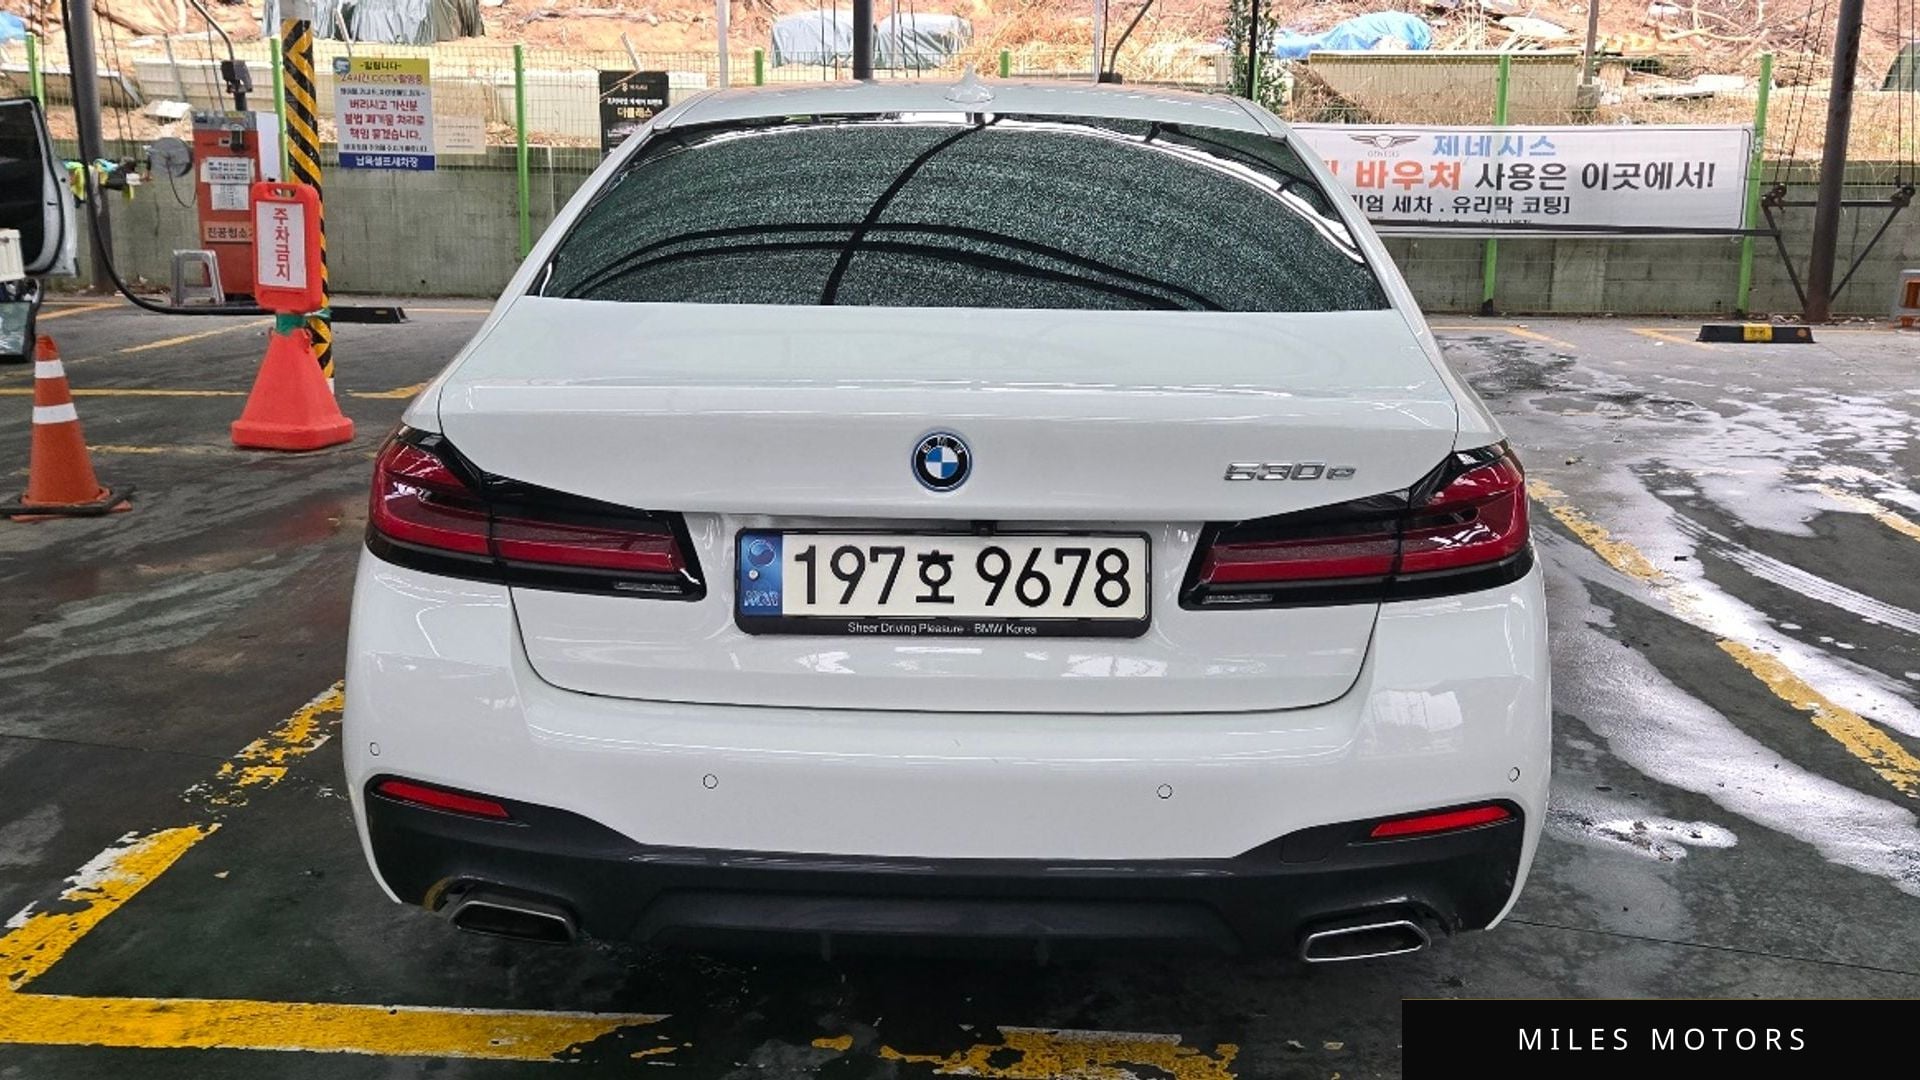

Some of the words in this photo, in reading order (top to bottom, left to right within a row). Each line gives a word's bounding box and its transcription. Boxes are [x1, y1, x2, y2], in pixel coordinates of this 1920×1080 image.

[350, 99, 387, 111] 버리시고
[390, 100, 418, 112] 가신분
[345, 113, 363, 125] 불법
[350, 127, 369, 140] 책임
[1433, 134, 1556, 158] 제네시스
[1355, 160, 1462, 191] 바우처
[1475, 162, 1567, 191] 사용은
[1581, 161, 1716, 191] 이곳에서!
[1392, 195, 1433, 214] 세차
[1452, 195, 1514, 215] 유리막
[1521, 195, 1570, 215] 코팅]
[273, 207, 291, 282] 주차금지
[795, 545, 955, 606] 197호
[976, 546, 1131, 608] 9678
[848, 622, 879, 633] Sheer
[881, 622, 917, 635] Driving
[919, 623, 964, 633] Pleasure
[975, 623, 1004, 633] BMW
[1006, 623, 1037, 634] Korea
